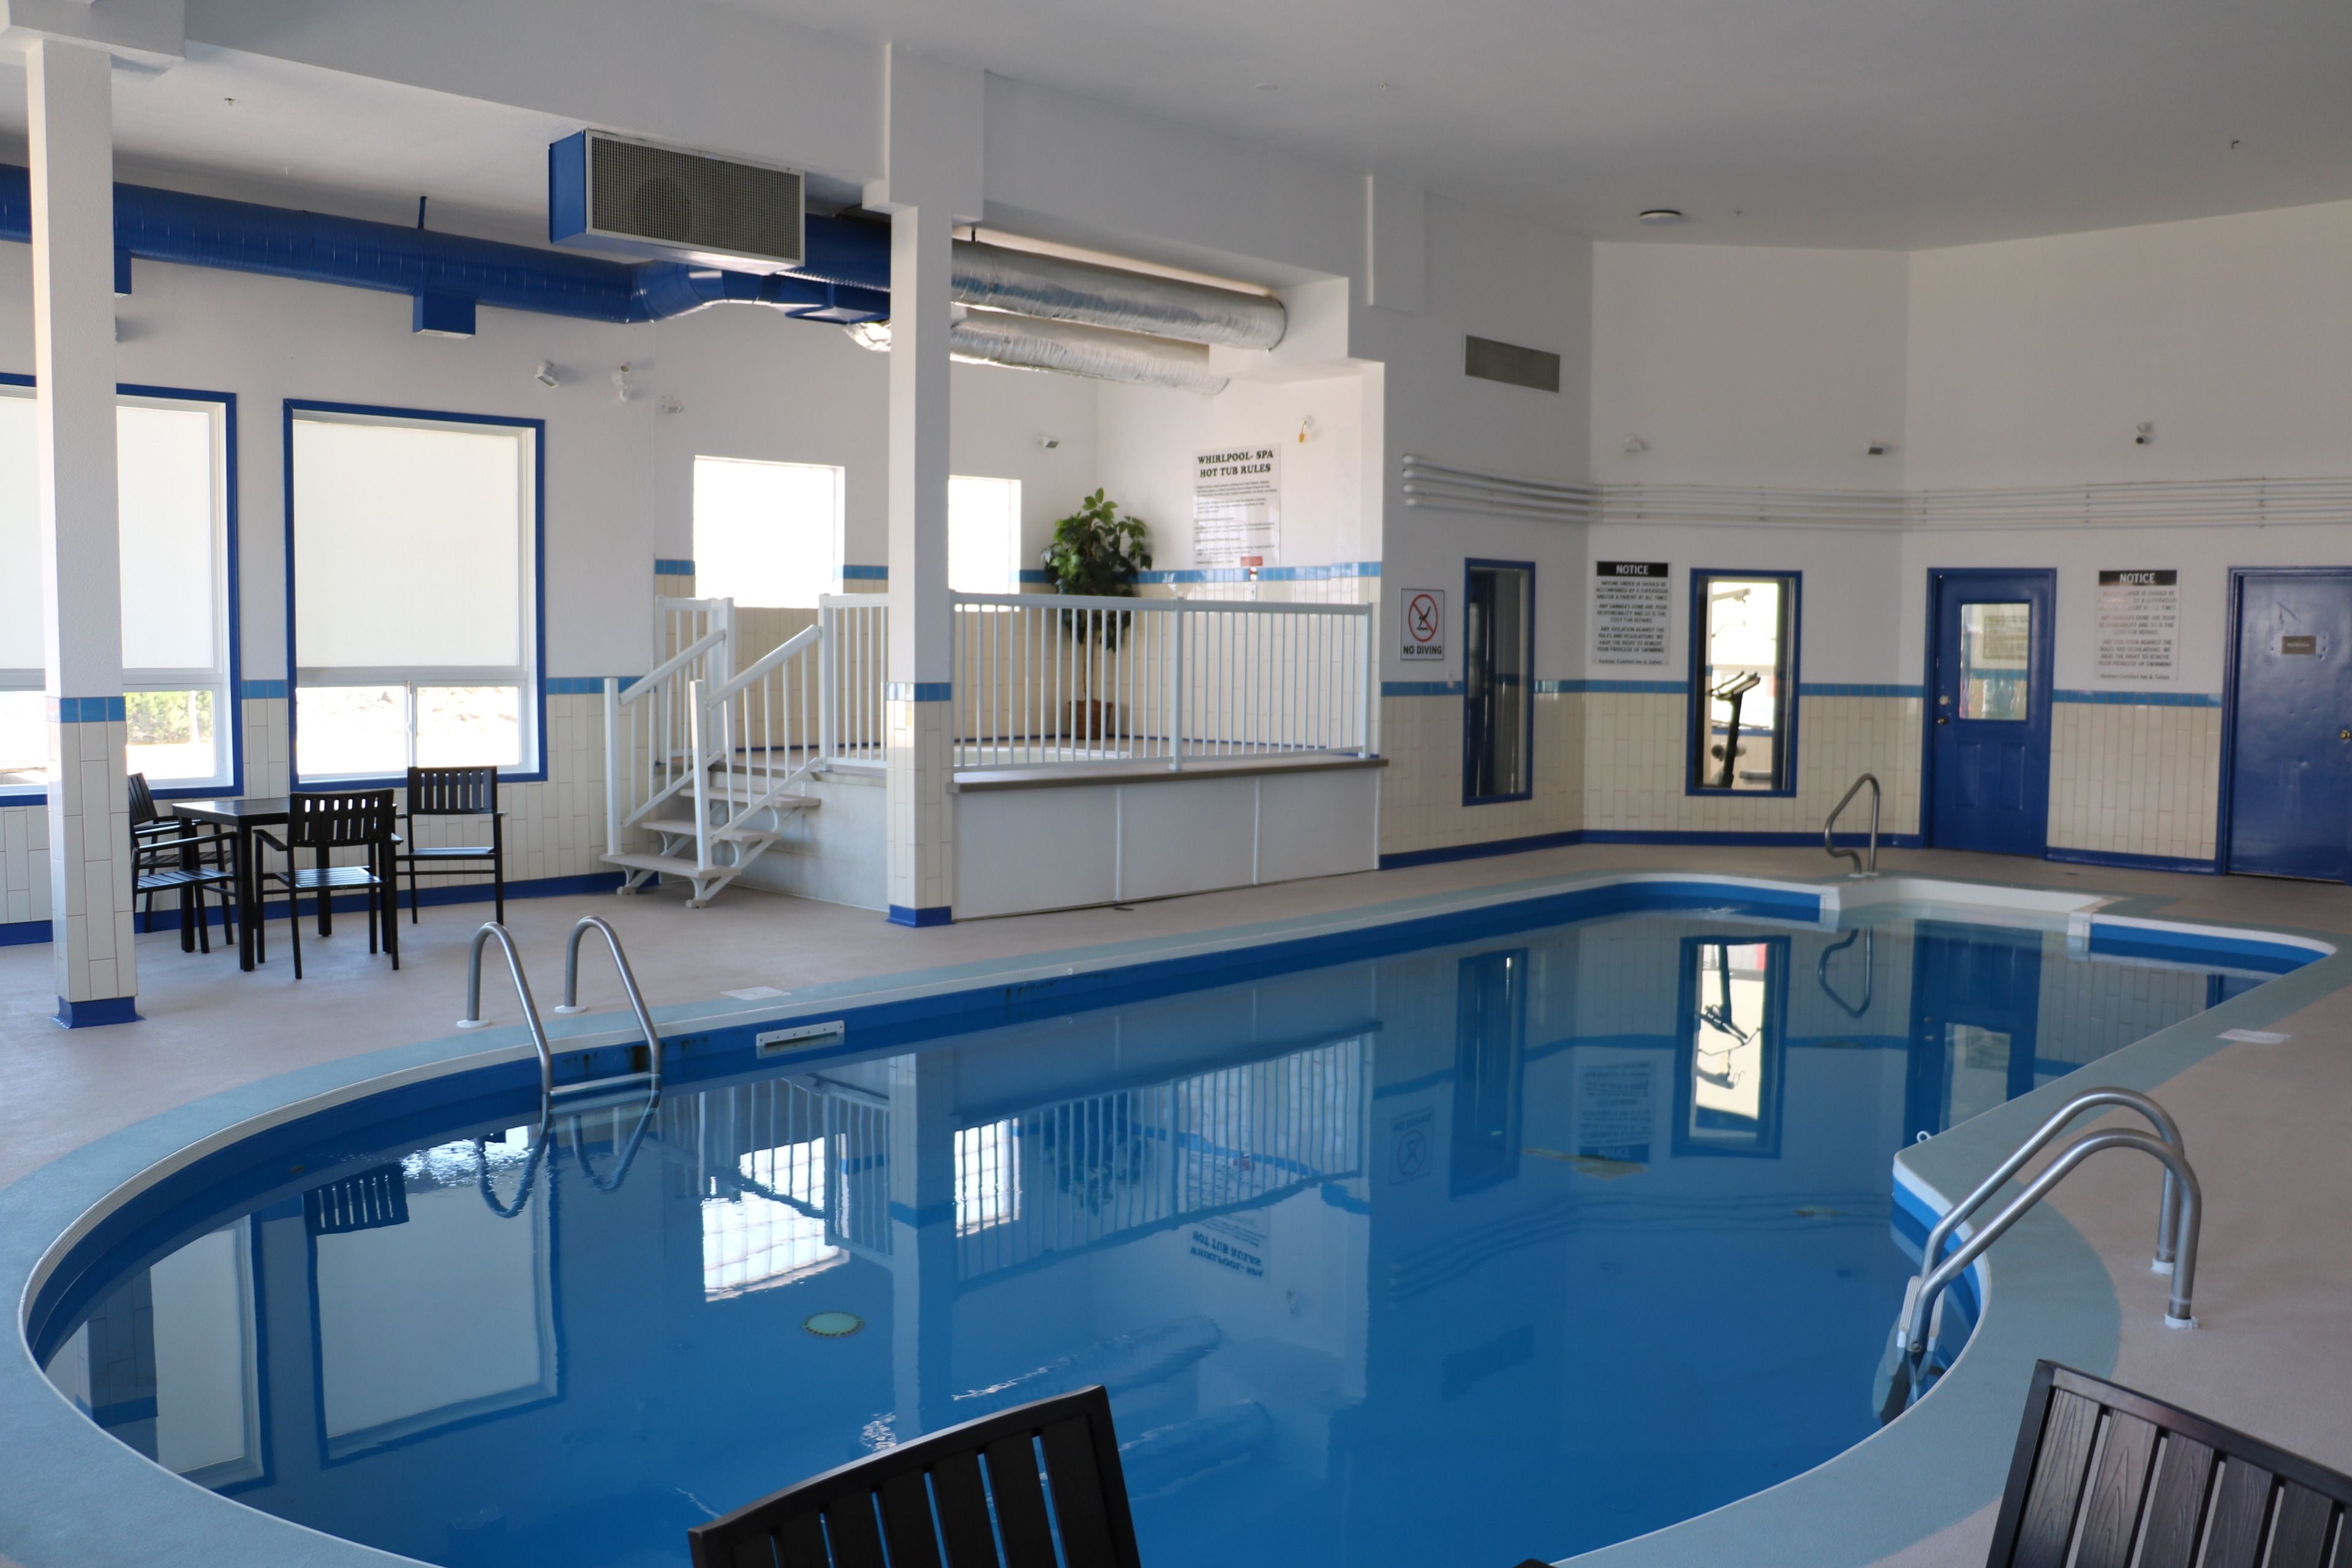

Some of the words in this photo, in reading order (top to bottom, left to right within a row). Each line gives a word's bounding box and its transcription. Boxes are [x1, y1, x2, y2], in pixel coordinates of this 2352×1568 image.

[1256, 450, 1273, 459] SPA
[1200, 467, 1218, 478] HOT
[1220, 466, 1238, 475] TUB
[1241, 464, 1271, 474] RULES
[1616, 564, 1649, 575] NOTICE
[2119, 573, 2156, 584] NOTICE
[1403, 645, 1414, 655] NO
[1417, 645, 1442, 655] DIVING
